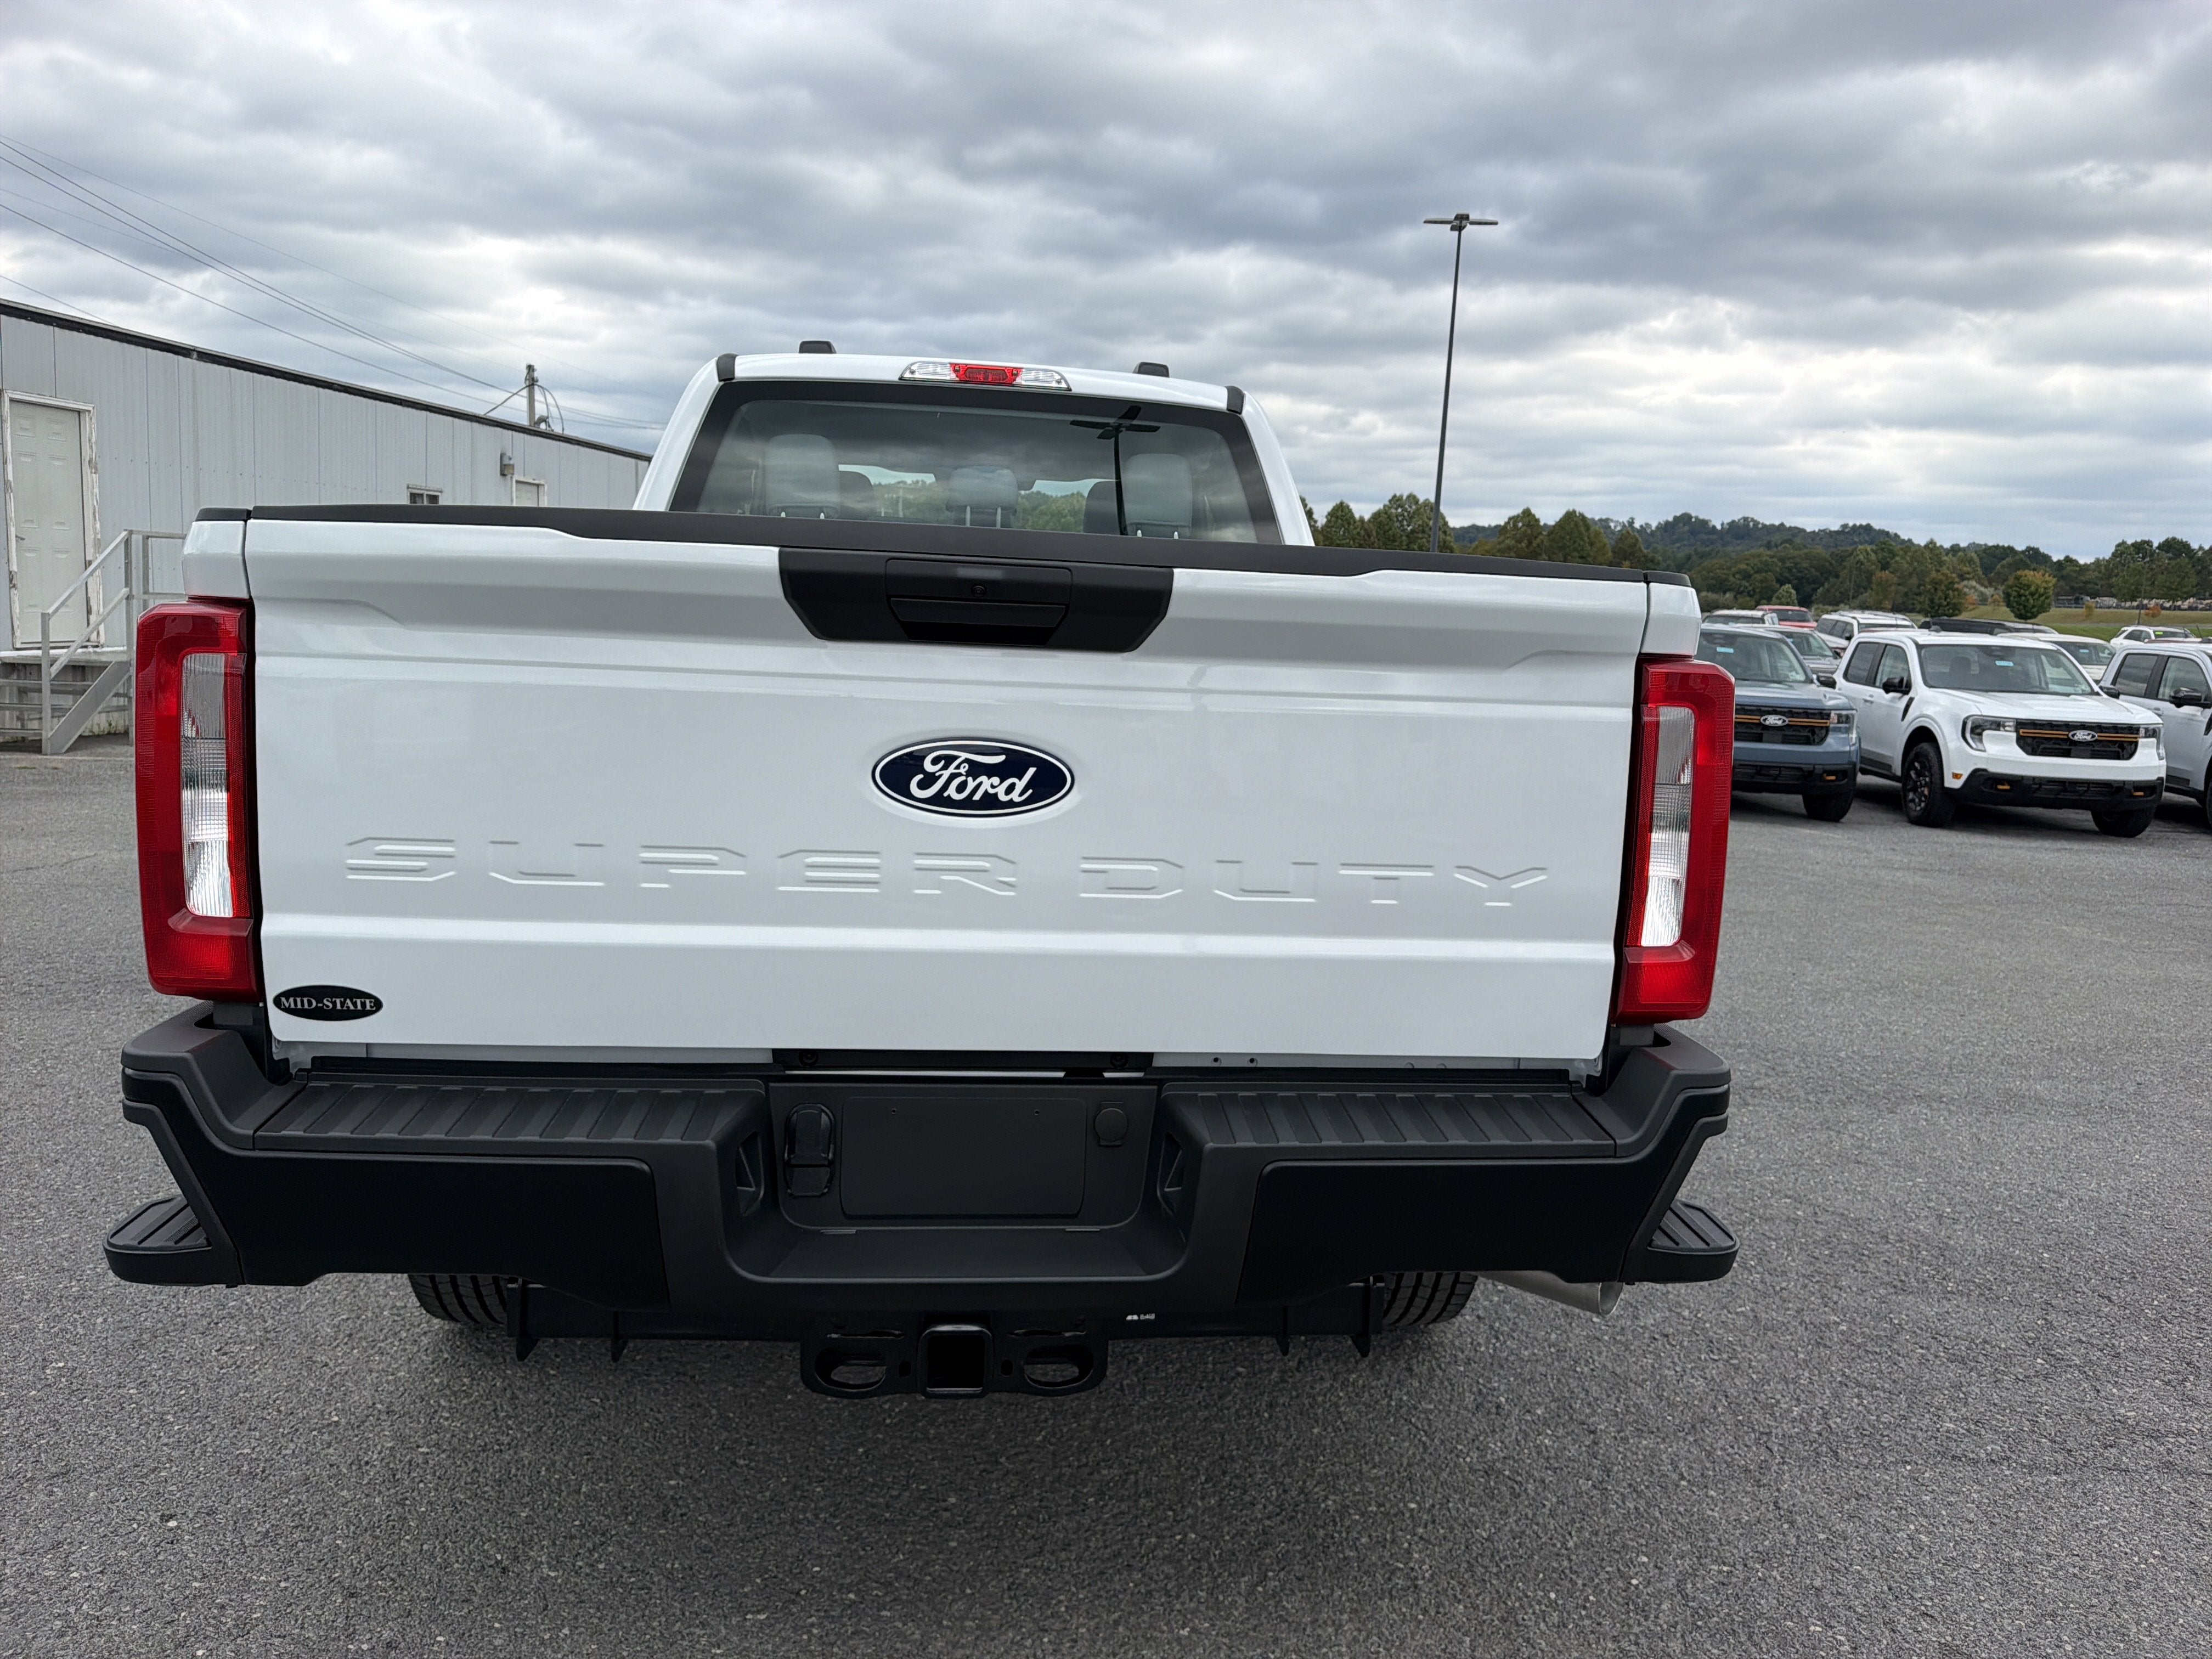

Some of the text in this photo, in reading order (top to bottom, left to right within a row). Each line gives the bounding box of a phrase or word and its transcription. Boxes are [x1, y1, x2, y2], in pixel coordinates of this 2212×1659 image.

[910, 749, 1037, 802] Ford
[346, 836, 1548, 907] SUPER DUTY
[280, 996, 376, 1011] MID-STATE
